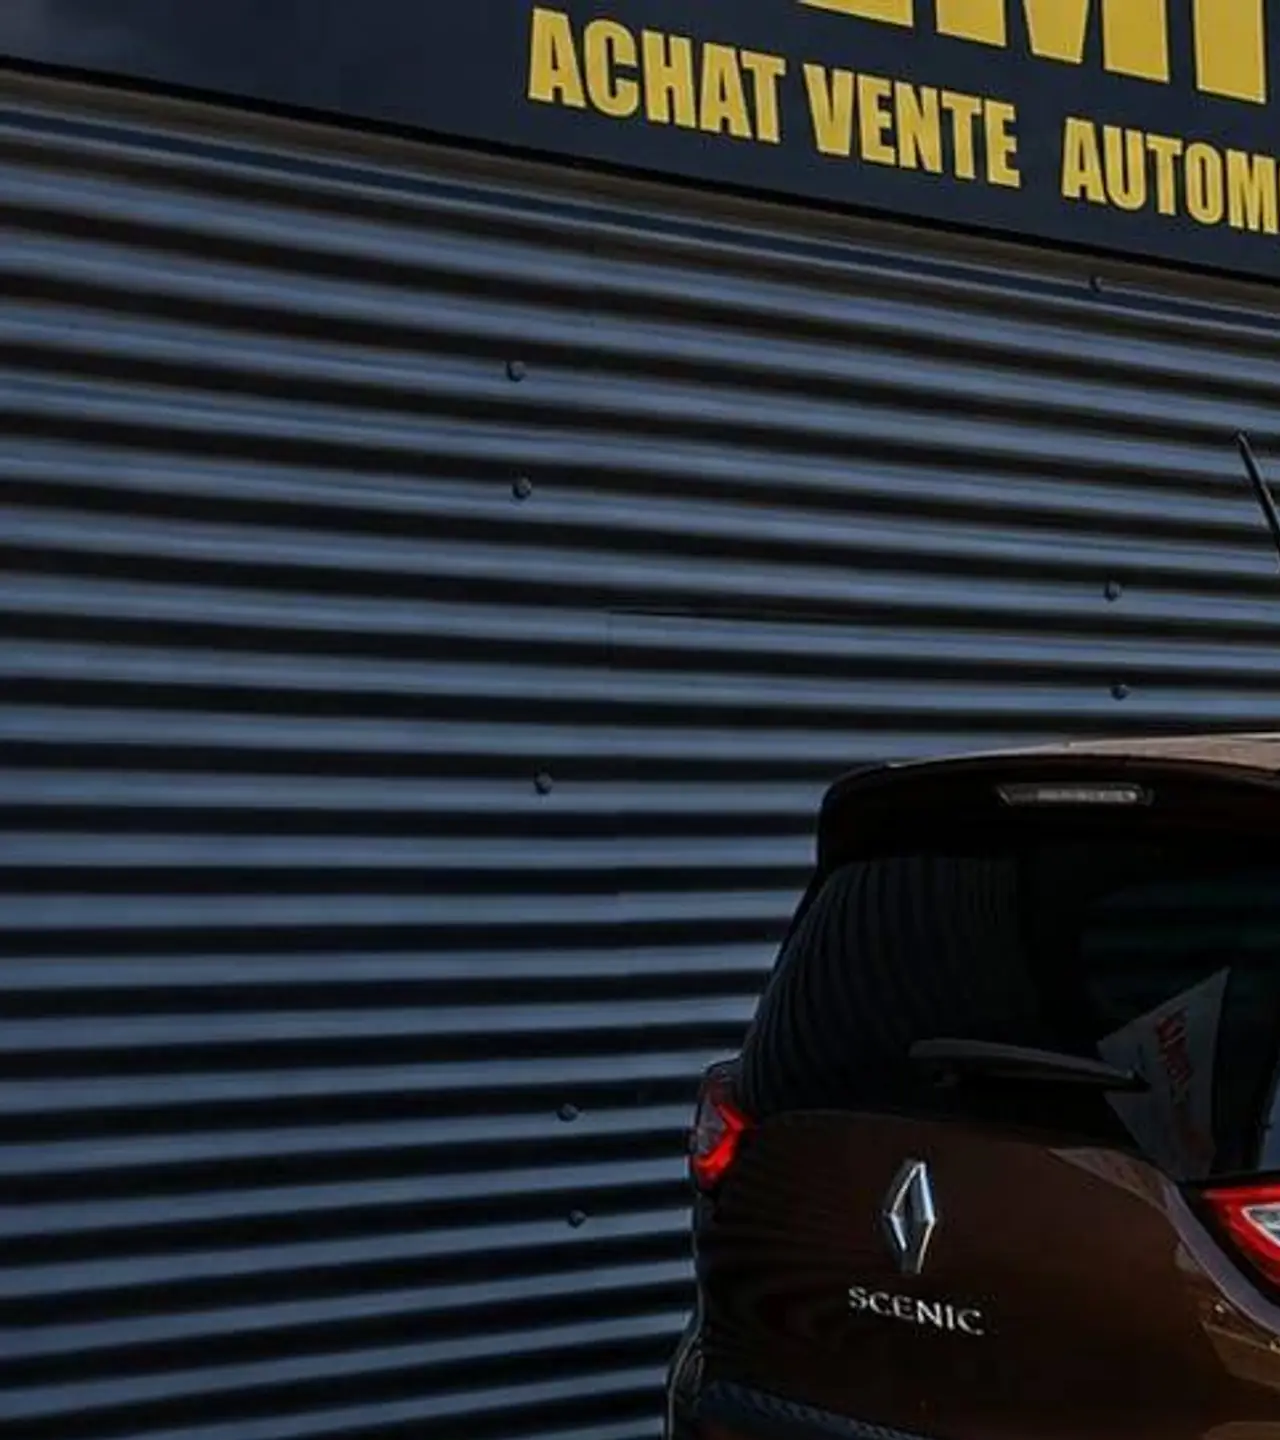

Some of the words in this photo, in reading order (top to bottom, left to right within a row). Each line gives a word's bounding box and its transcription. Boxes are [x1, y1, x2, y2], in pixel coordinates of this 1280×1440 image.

[528, 8, 784, 143] ACHAT
[804, 64, 1020, 187] VENTE
[847, 1286, 985, 1336] SCENIC
